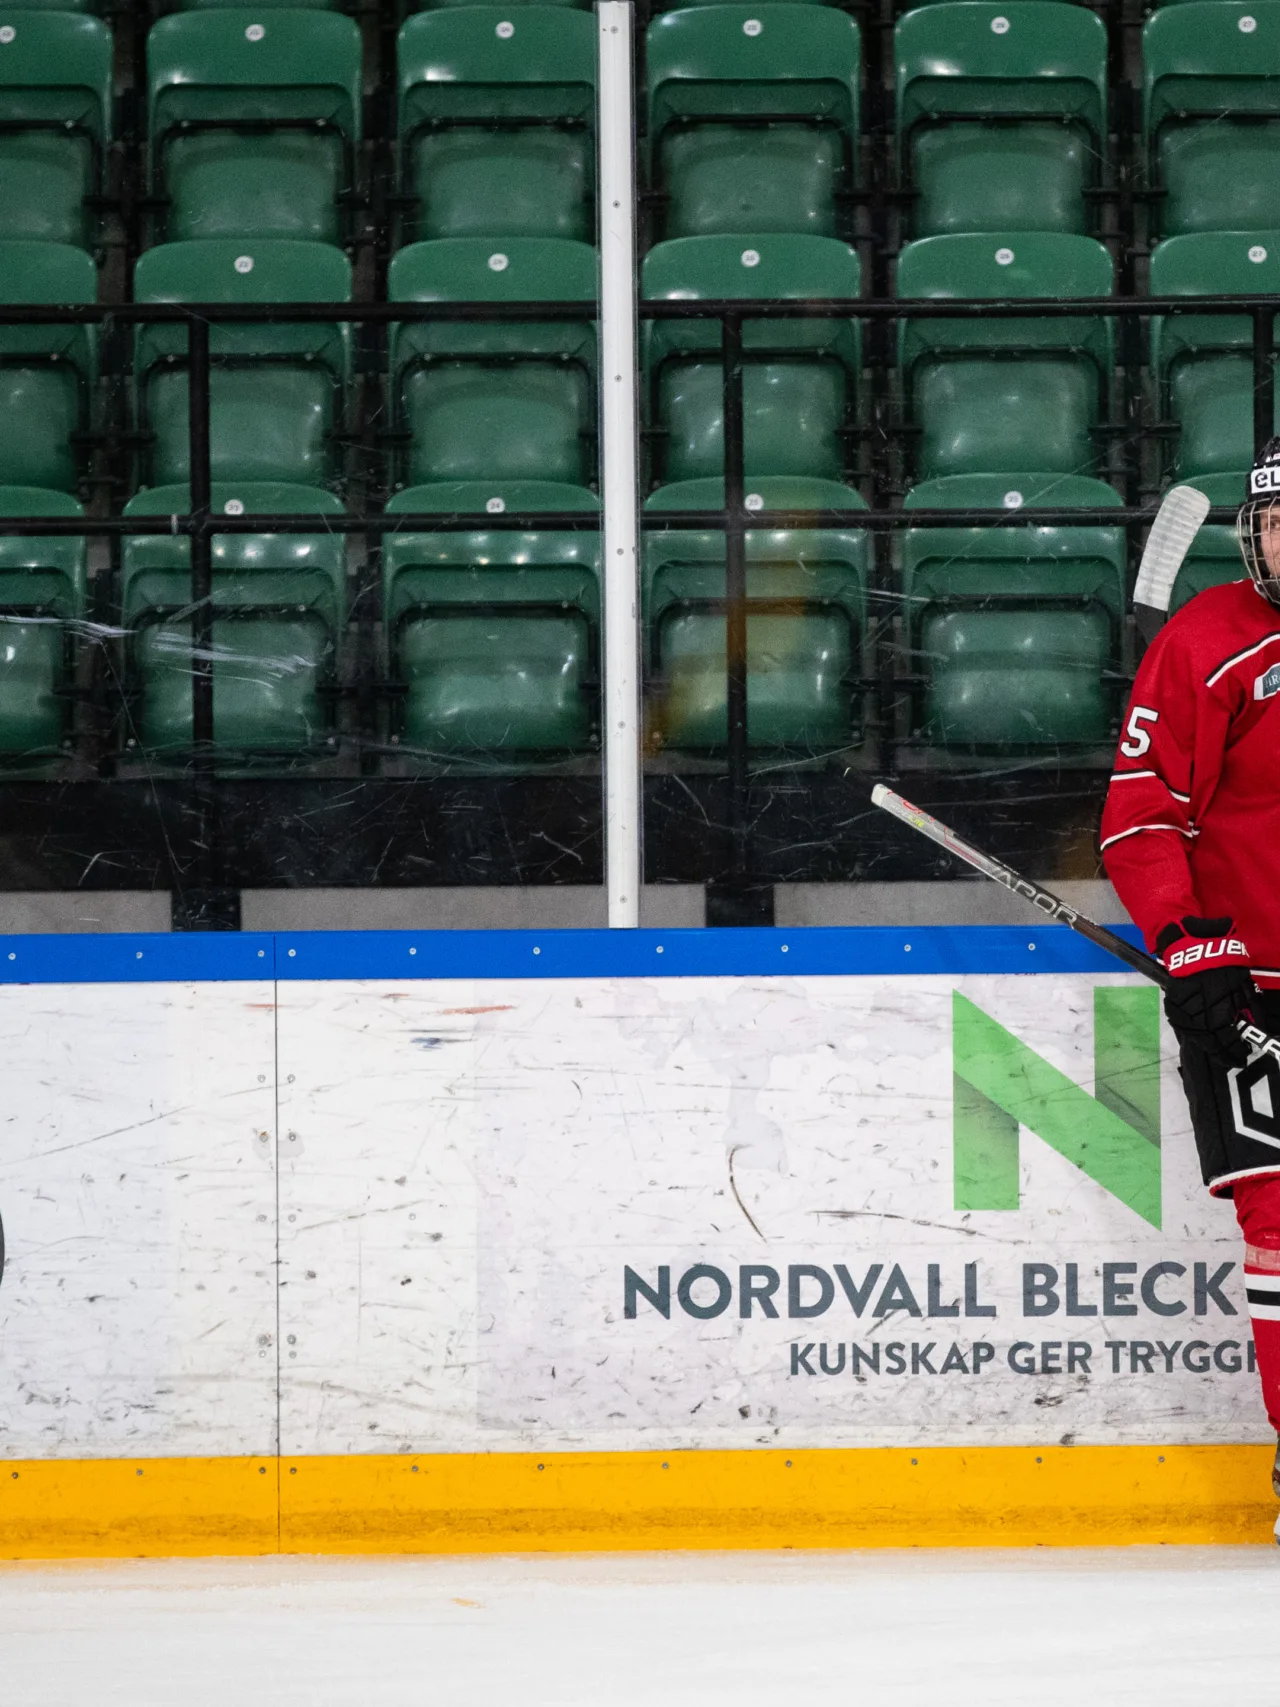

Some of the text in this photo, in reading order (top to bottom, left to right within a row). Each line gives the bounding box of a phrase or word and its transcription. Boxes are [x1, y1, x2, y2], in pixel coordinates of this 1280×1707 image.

[1121, 706, 1158, 758] 5
[624, 1261, 1239, 1320] NORDVALL BLECK
[791, 1341, 995, 1376] KUNSKAP
[1007, 1341, 1093, 1375] GER
